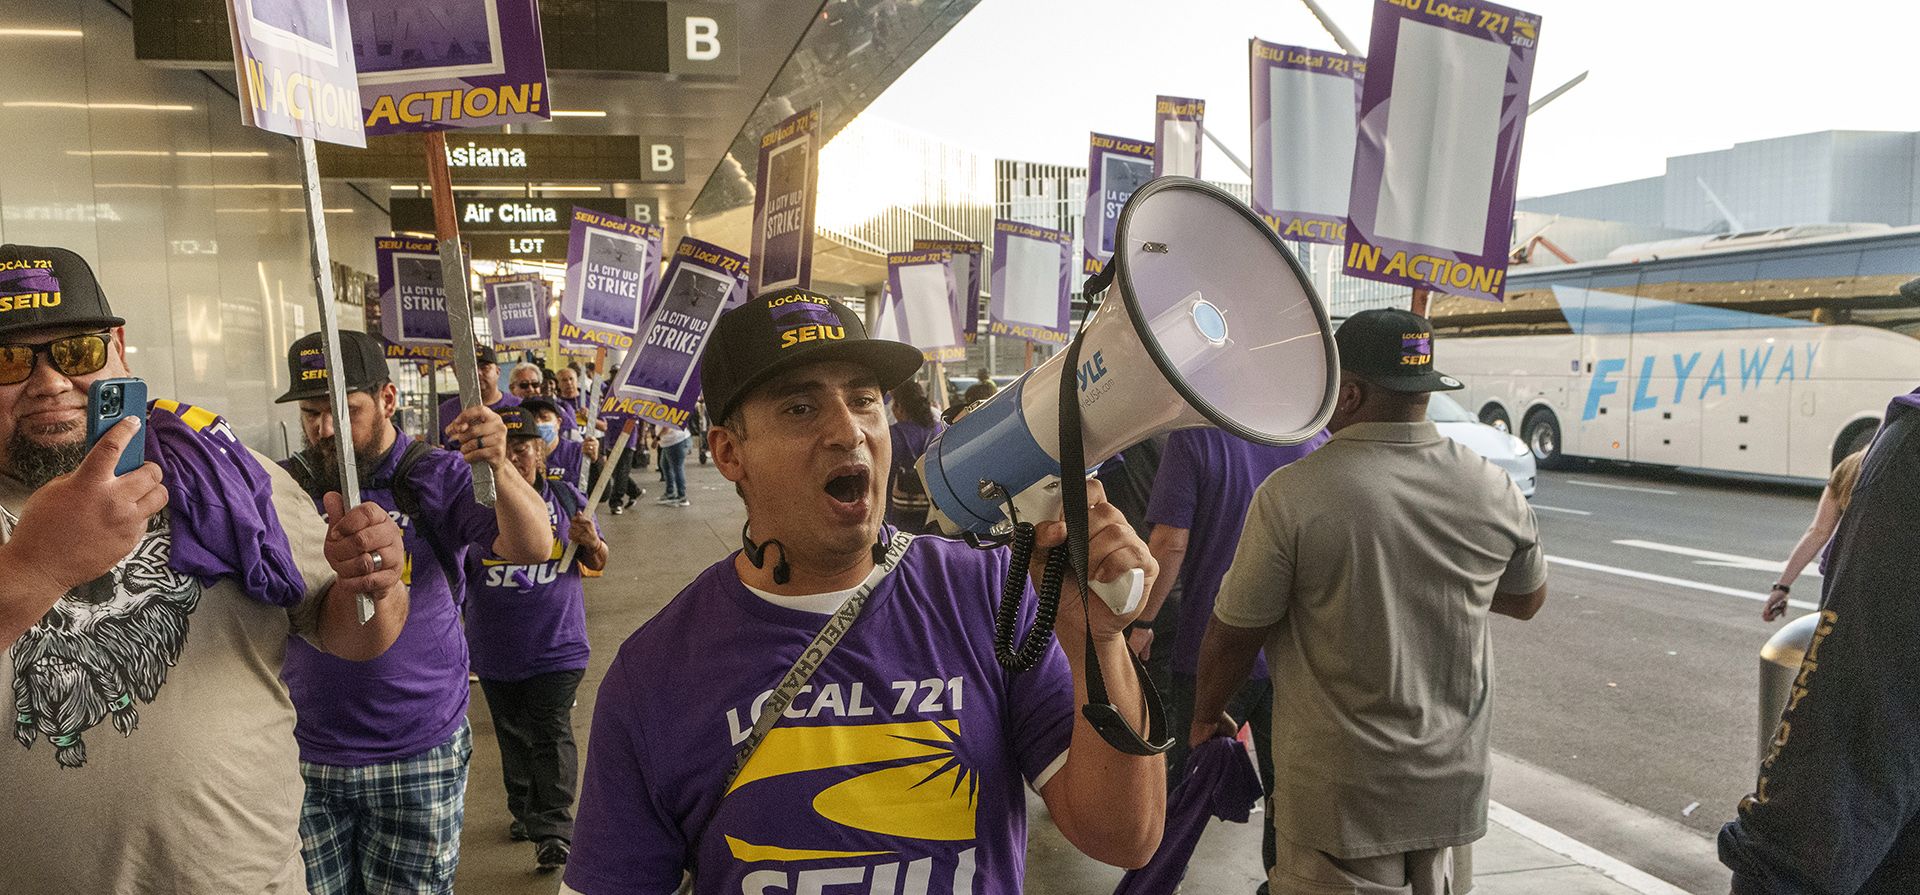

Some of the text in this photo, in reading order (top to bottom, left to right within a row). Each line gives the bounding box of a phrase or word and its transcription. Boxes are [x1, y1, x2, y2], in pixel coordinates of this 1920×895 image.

[1425, 0, 1475, 24] Local
[1477, 10, 1510, 34] 721
[685, 16, 721, 60] B
[1254, 45, 1284, 62] SEIU
[1288, 52, 1322, 68] Local
[1327, 56, 1348, 72] 721
[272, 66, 360, 132] ACTION!
[365, 82, 542, 127] ACTION!
[651, 144, 675, 172] B
[1090, 136, 1155, 156] SEIU Local 72
[768, 189, 802, 214] LA CITY ULP
[1106, 190, 1117, 200] LA
[464, 204, 557, 222] Air China
[574, 212, 599, 224] SEIU
[600, 218, 626, 231] Local
[628, 224, 646, 236] 721
[634, 204, 651, 223] B
[767, 206, 800, 240] STRIKE
[1020, 226, 1041, 236] Local
[1043, 231, 1058, 240] 721
[406, 241, 432, 250] Local
[509, 238, 545, 254] LOT
[0, 260, 52, 272] OCAL 721
[695, 246, 720, 265] Local
[720, 256, 740, 272] 721
[908, 254, 926, 263] Local
[1086, 258, 1103, 272] IN
[1347, 242, 1504, 294] IN ACTION!
[588, 262, 639, 281] LA CITY ULP
[402, 286, 412, 294] LA
[415, 286, 434, 295] CITY
[587, 274, 637, 298] STRIKE
[0, 292, 61, 312] SEIU
[404, 296, 445, 312] STRIK
[768, 294, 830, 308] LOCAL 721
[502, 308, 534, 320] STRIKE
[658, 309, 708, 332] LA CITY ULP
[561, 324, 633, 348] IN ACTIO
[648, 325, 700, 355] STRIKE
[781, 325, 846, 349] SEIU
[991, 322, 1068, 344] IN ACTION!
[387, 345, 454, 358] IN ACTIO
[1400, 355, 1431, 365] SEIU
[1076, 350, 1107, 392] YLE
[1582, 342, 1820, 422] FLYAWAY
[1079, 378, 1115, 413] yleUSA.com
[601, 396, 690, 426] IN ACTION!
[486, 561, 558, 587] SEIU
[891, 676, 964, 716] 721
